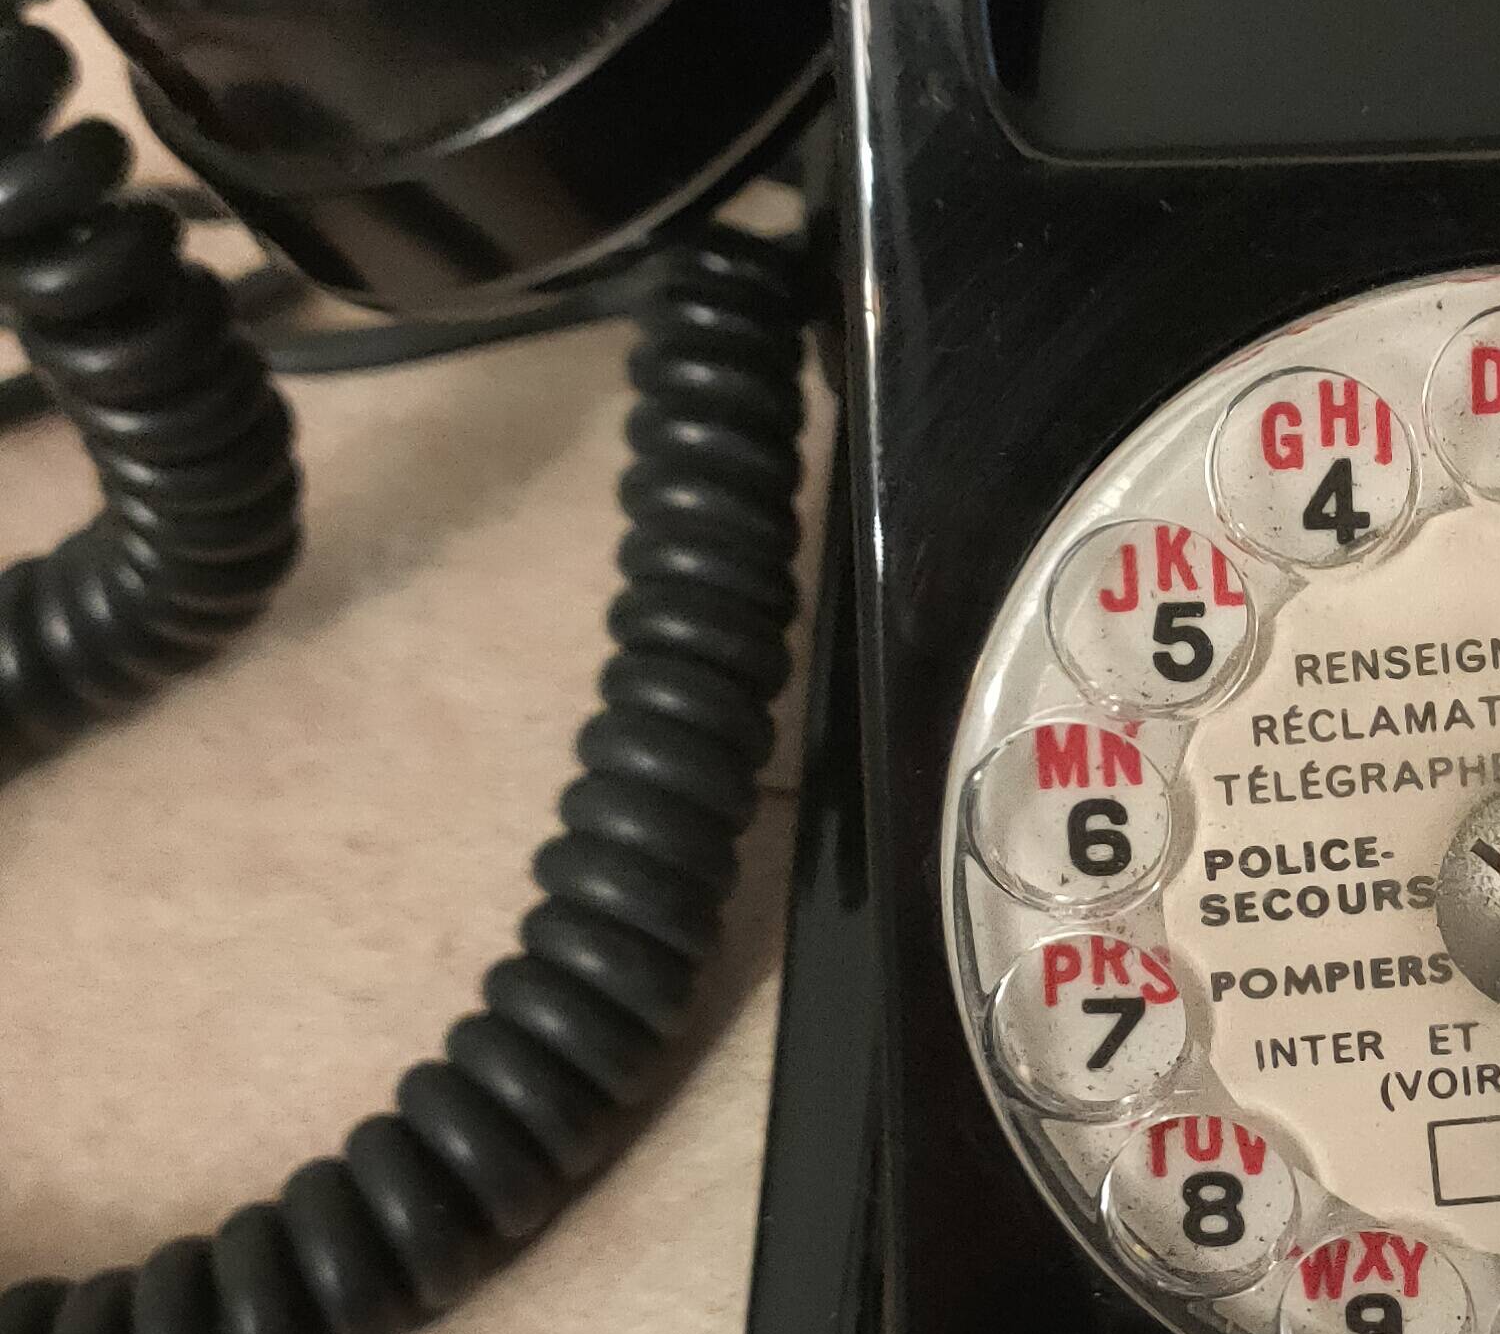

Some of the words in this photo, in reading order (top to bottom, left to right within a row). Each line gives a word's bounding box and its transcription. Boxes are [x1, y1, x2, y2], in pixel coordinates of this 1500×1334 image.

[1260, 379, 1392, 471] GHI
[1302, 457, 1371, 546] 4
[1098, 525, 1245, 613] JKL
[1153, 602, 1214, 683] 5
[1033, 721, 1145, 791] MN
[1067, 798, 1131, 876] 6
[1204, 837, 1393, 881] POLICE-
[1200, 874, 1438, 927] SECOURS
[1211, 952, 1455, 1002] POMPIERS
[1082, 996, 1145, 1071] 7
[1256, 1031, 1384, 1071] INTER
[1429, 1023, 1479, 1055] ET
[1182, 1171, 1245, 1250] 8
[1298, 1230, 1429, 1301] WXY
